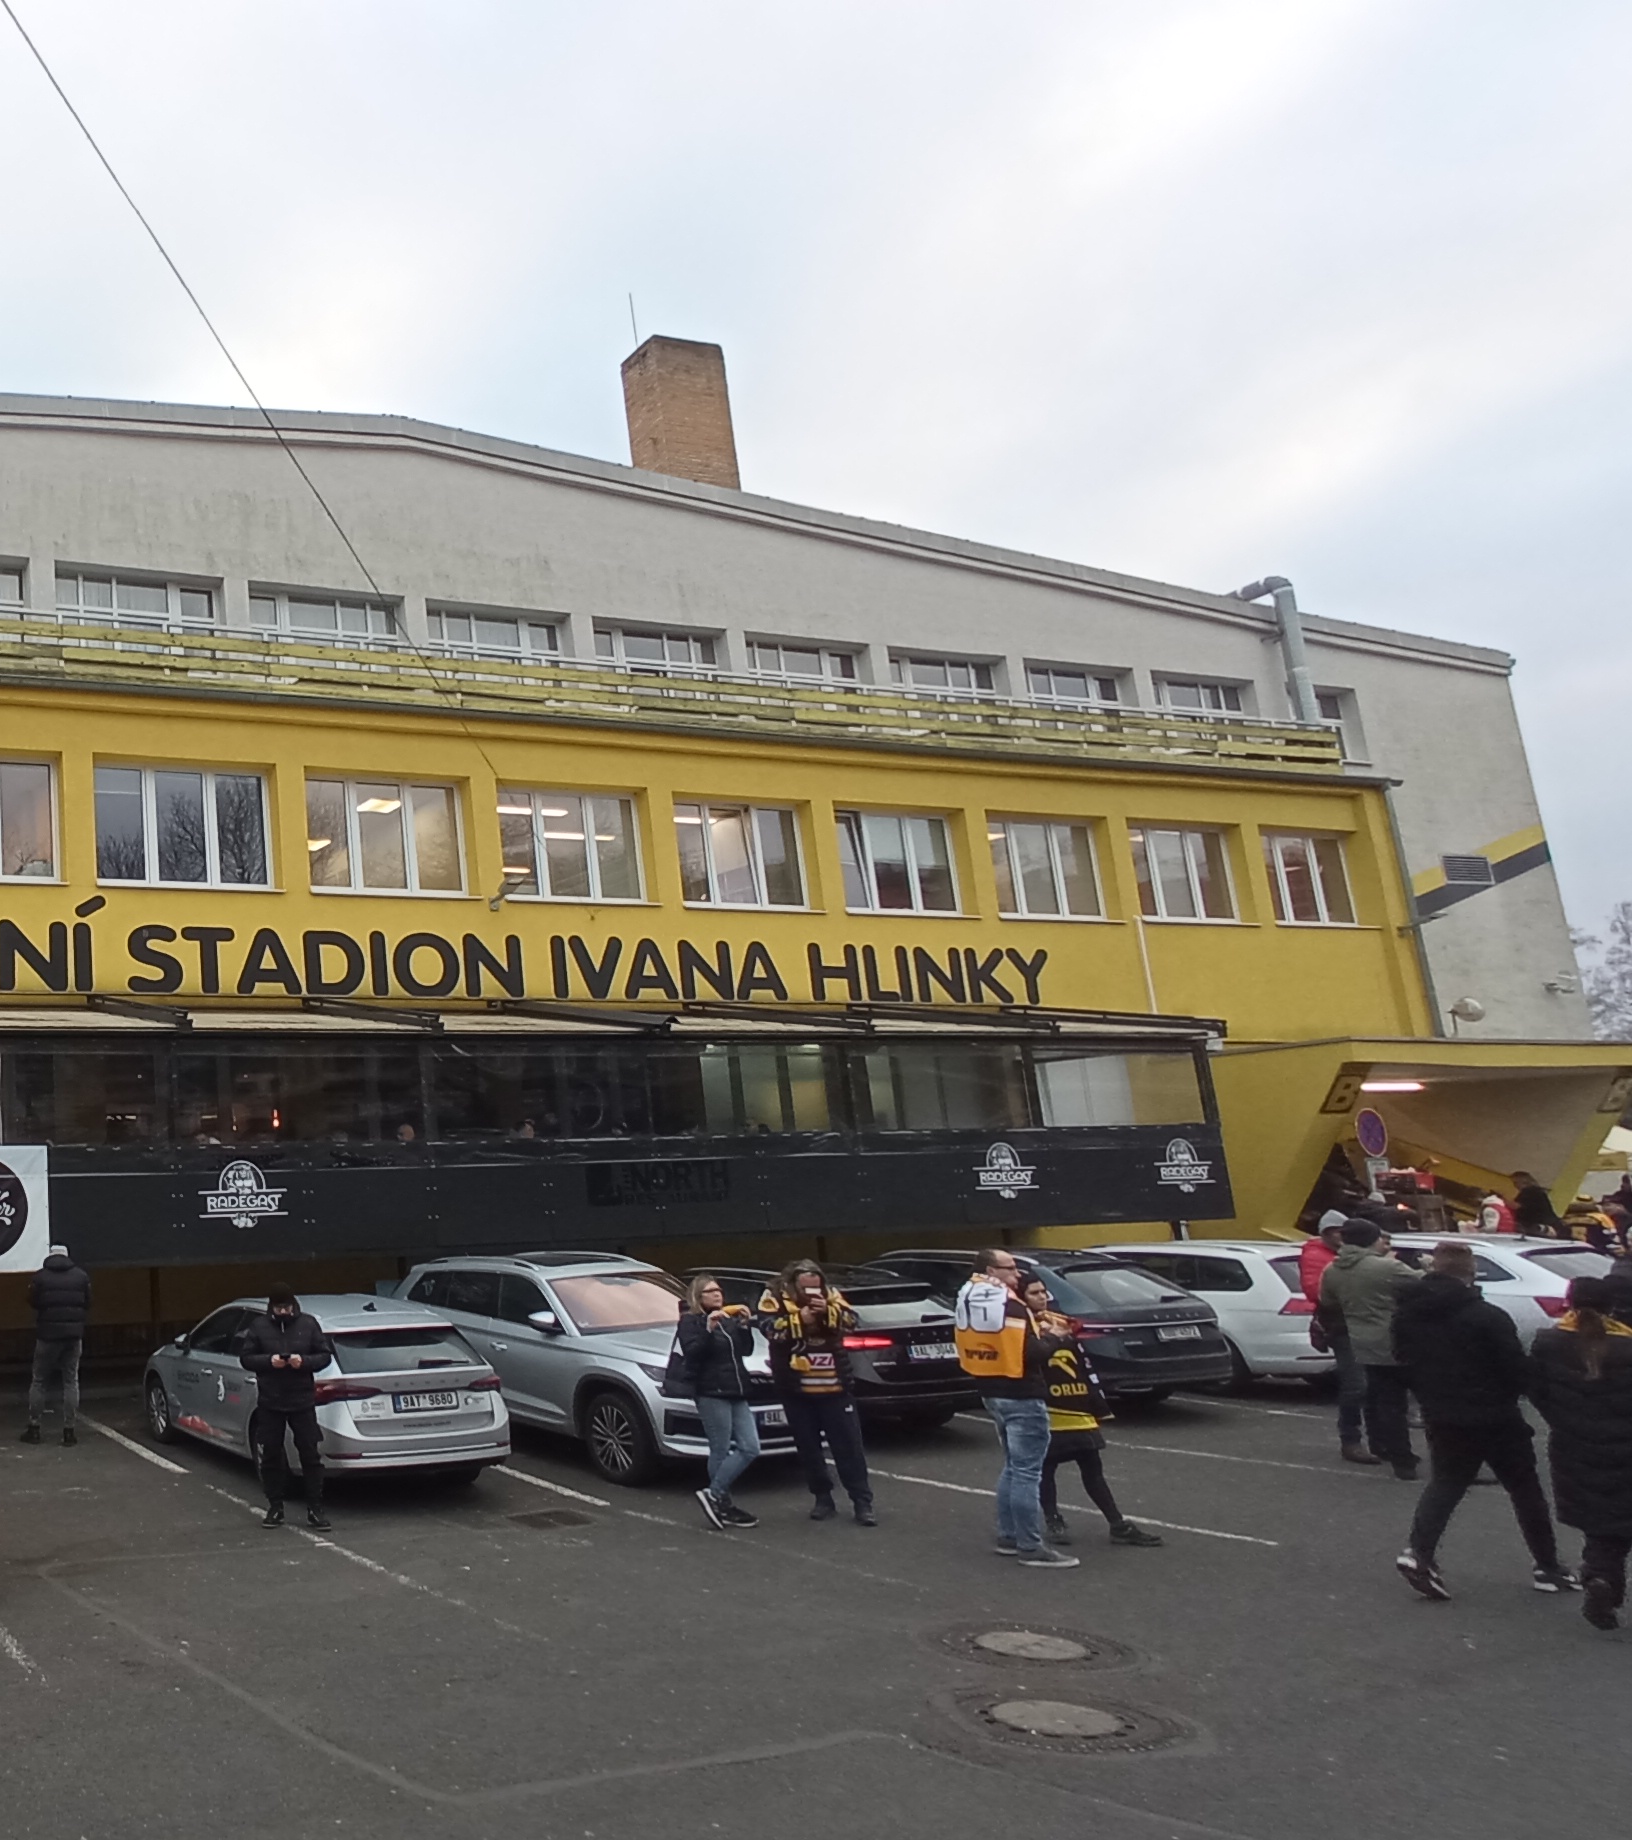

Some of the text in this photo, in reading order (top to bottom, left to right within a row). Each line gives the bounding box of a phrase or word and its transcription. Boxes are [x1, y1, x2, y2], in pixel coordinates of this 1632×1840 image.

[127, 924, 525, 998] STADION
[549, 934, 789, 1000] IVANA
[807, 941, 1049, 1005] HLINKY
[206, 1193, 283, 1211] RADEGAST
[402, 1394, 422, 1408] 9AT
[429, 1392, 454, 1406] 9680
